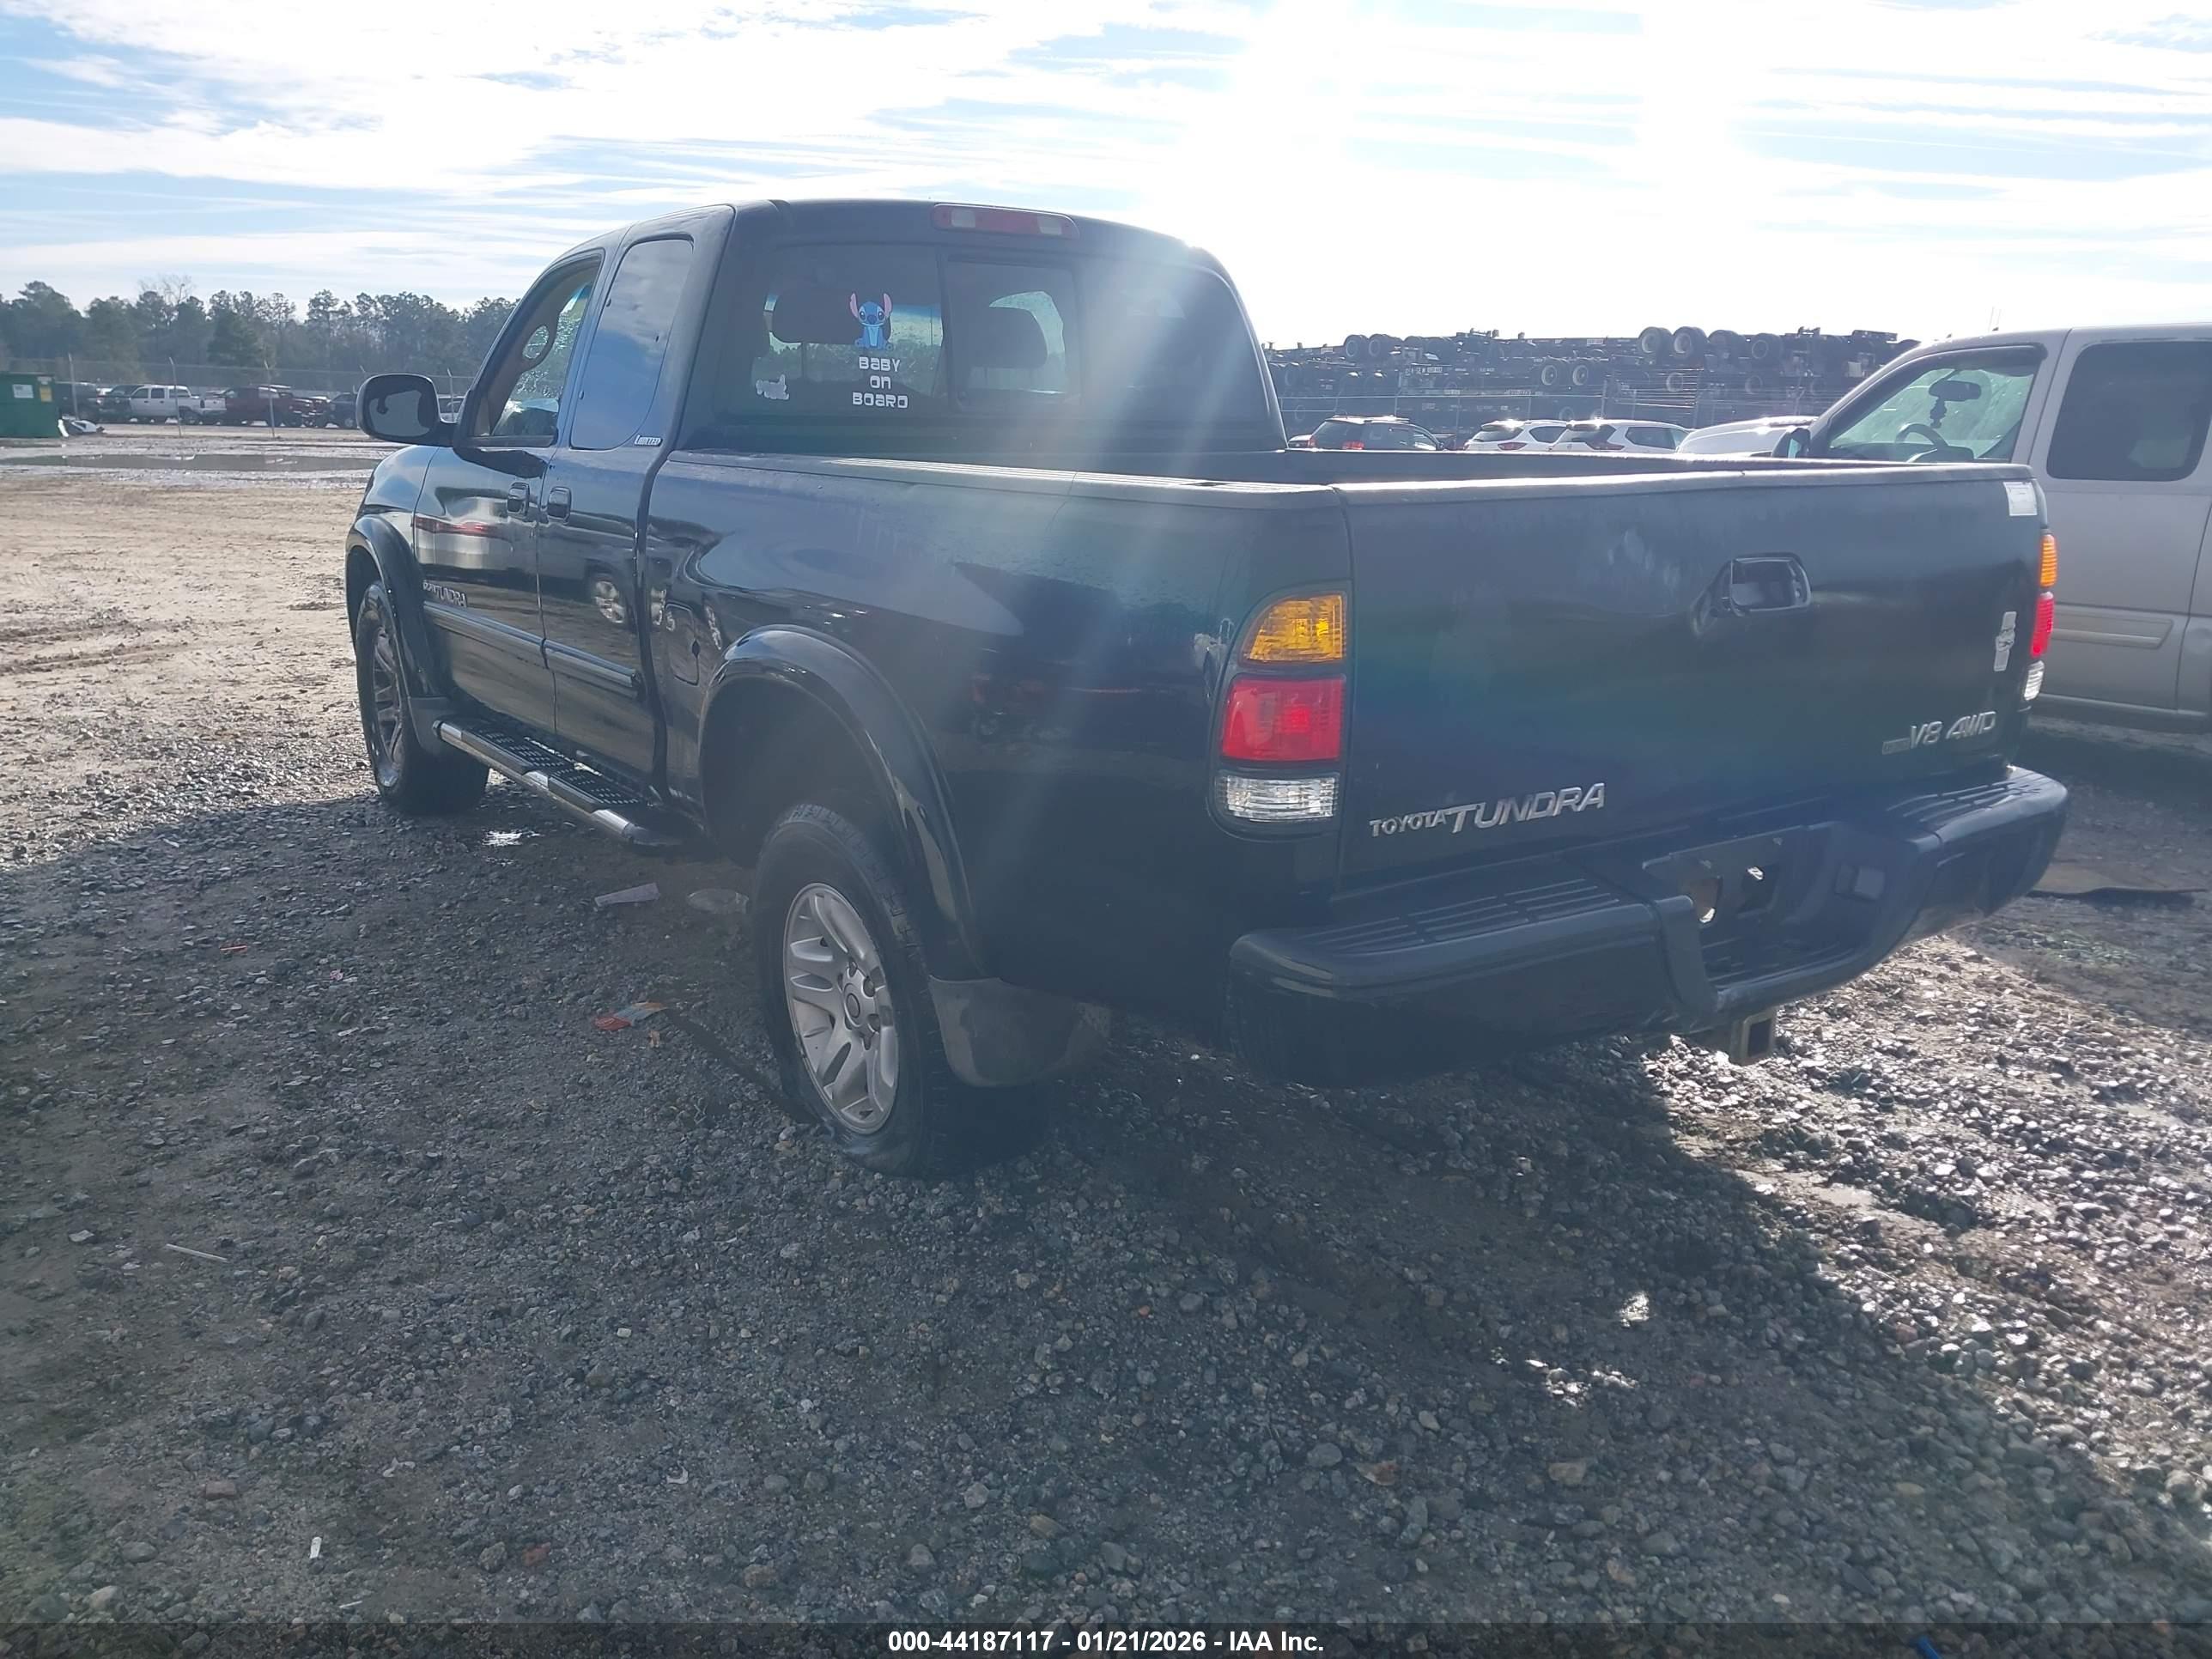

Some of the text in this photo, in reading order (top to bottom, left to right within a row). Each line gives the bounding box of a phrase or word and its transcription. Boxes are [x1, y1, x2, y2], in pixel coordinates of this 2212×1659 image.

[1911, 721, 1942, 750] V8
[1369, 782, 1606, 836] TOYOTA TUNDRA
